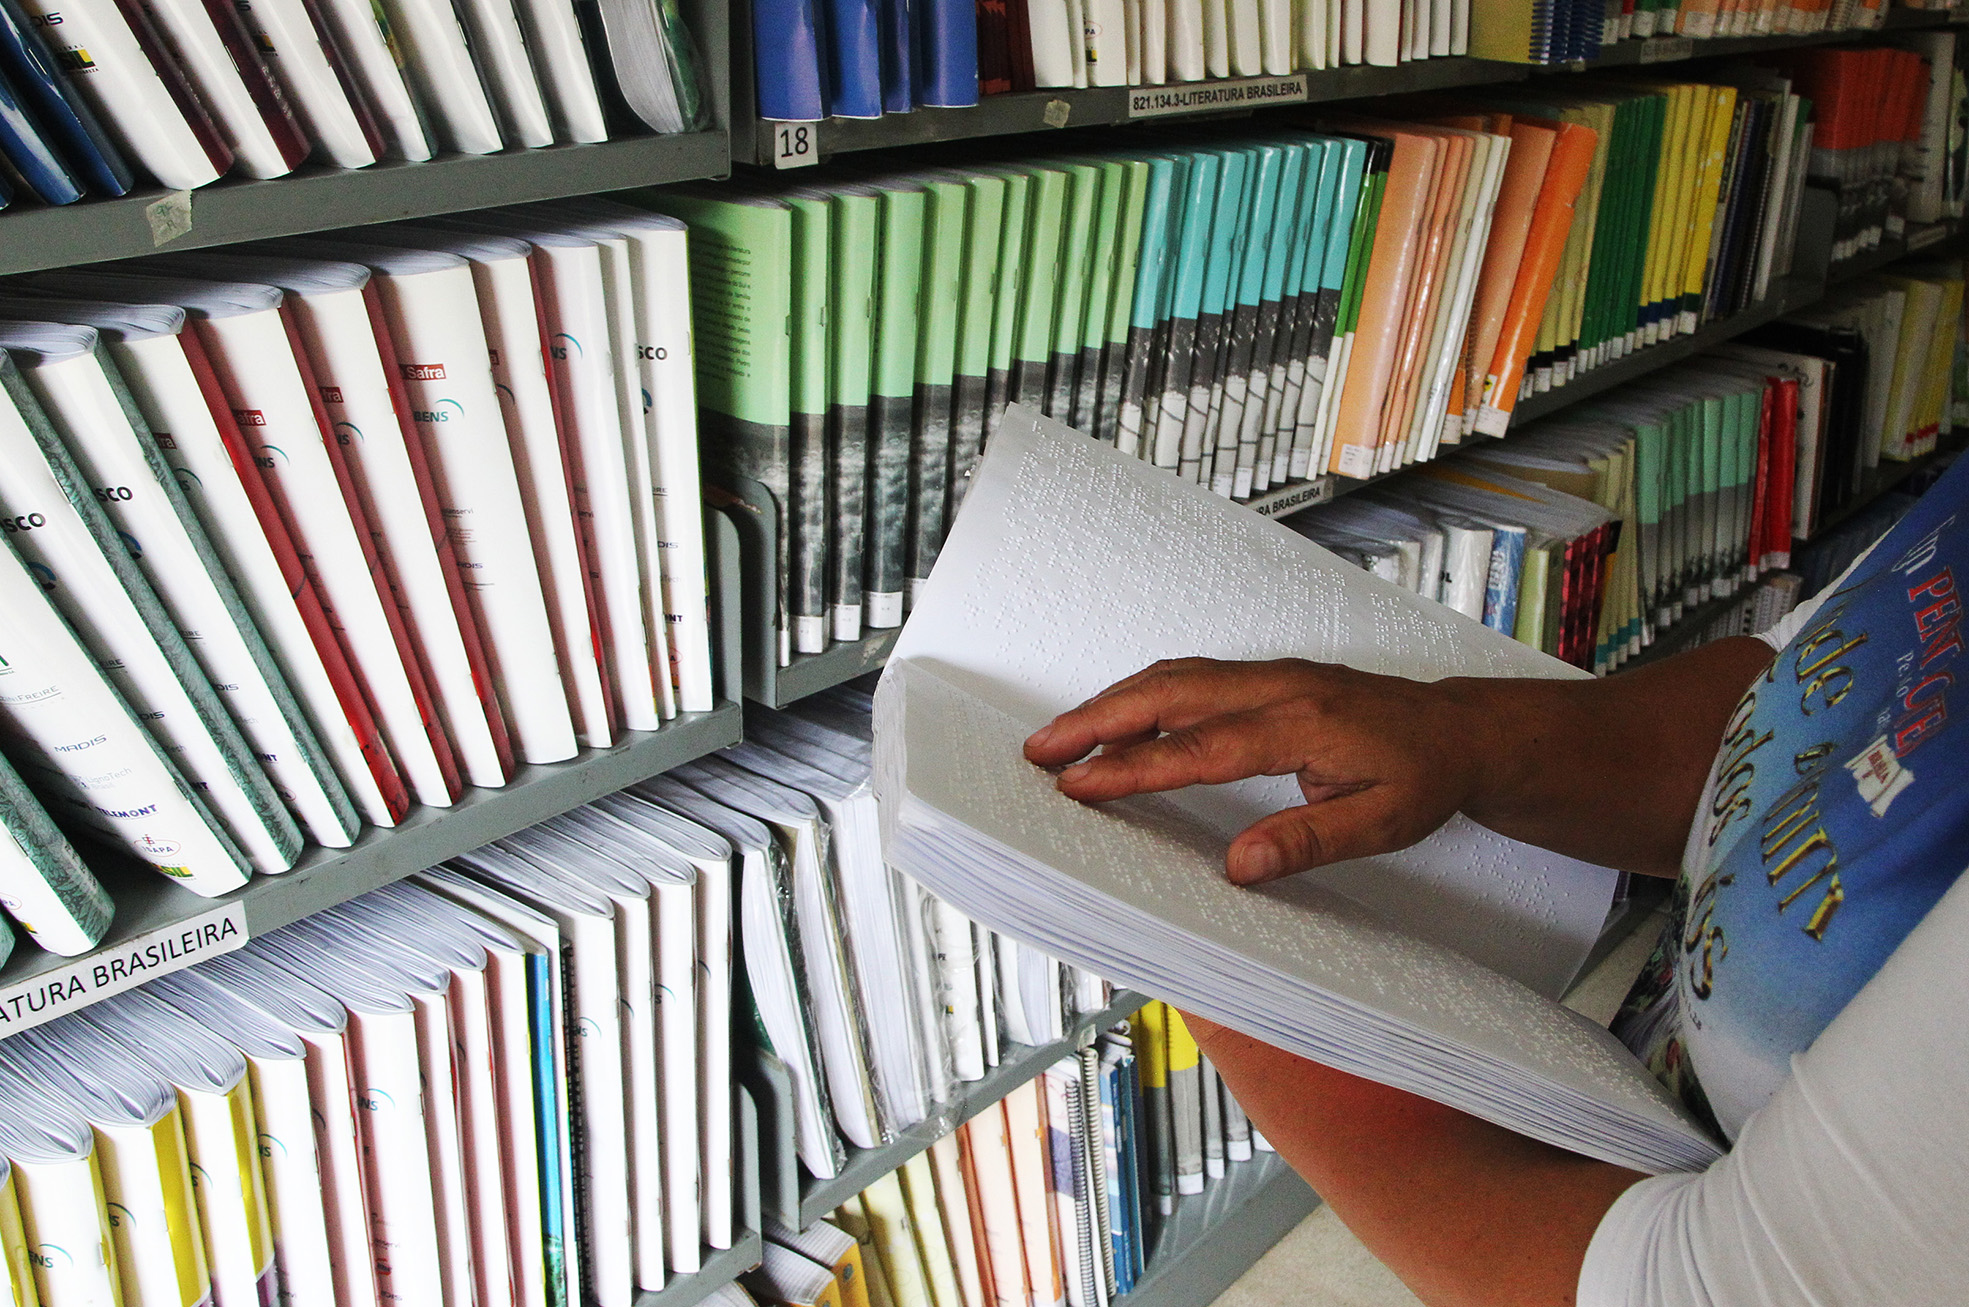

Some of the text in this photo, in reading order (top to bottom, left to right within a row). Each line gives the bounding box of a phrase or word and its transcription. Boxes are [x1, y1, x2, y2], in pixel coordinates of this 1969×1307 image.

[1133, 81, 1303, 111] 821.134.3-LITERATURA BRASILEIRA
[780, 126, 809, 158] 18
[406, 365, 445, 380] Safra
[1273, 486, 1321, 513] BRASILEIRA
[92, 916, 239, 989] BRASILEIRA
